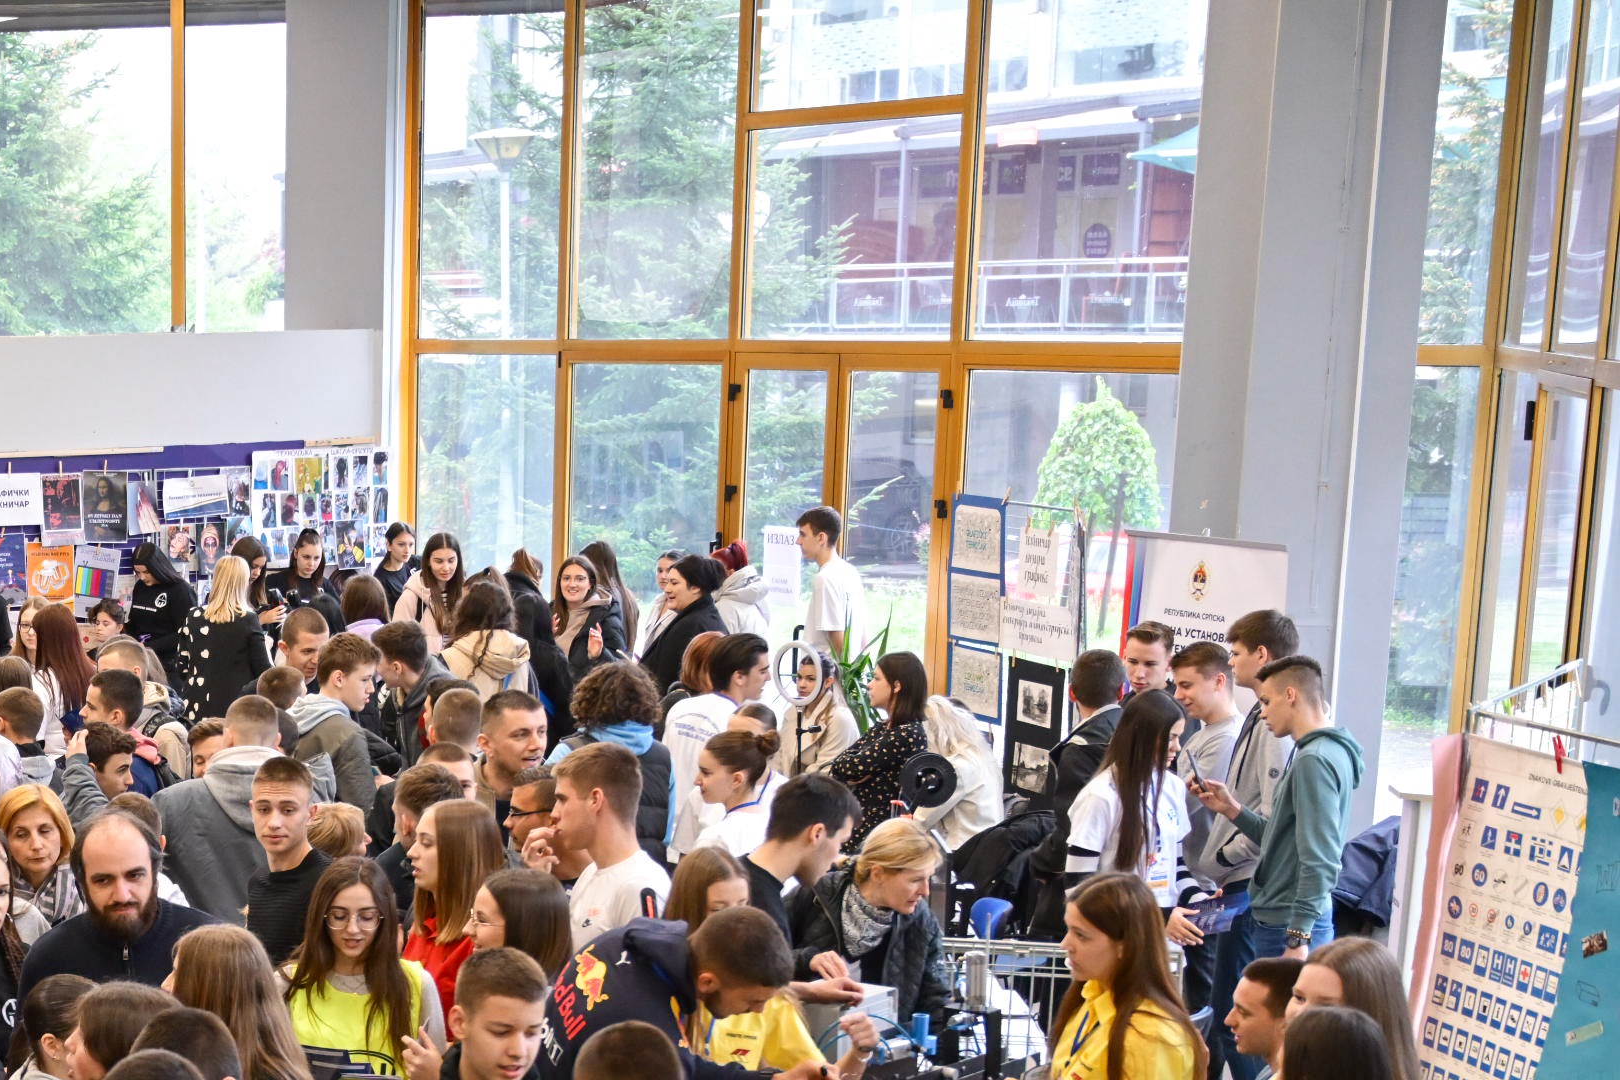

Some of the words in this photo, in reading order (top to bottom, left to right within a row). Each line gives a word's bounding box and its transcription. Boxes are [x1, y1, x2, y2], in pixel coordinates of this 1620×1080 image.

[767, 533, 795, 545] ИЗЛАЗ
[1164, 608, 1201, 620] РЕПУБЛИКА
[1202, 613, 1225, 623] СРПСКА
[1528, 773, 1551, 785] ZNAKOVI
[1474, 868, 1485, 882] 60
[558, 991, 587, 1040] Bull
